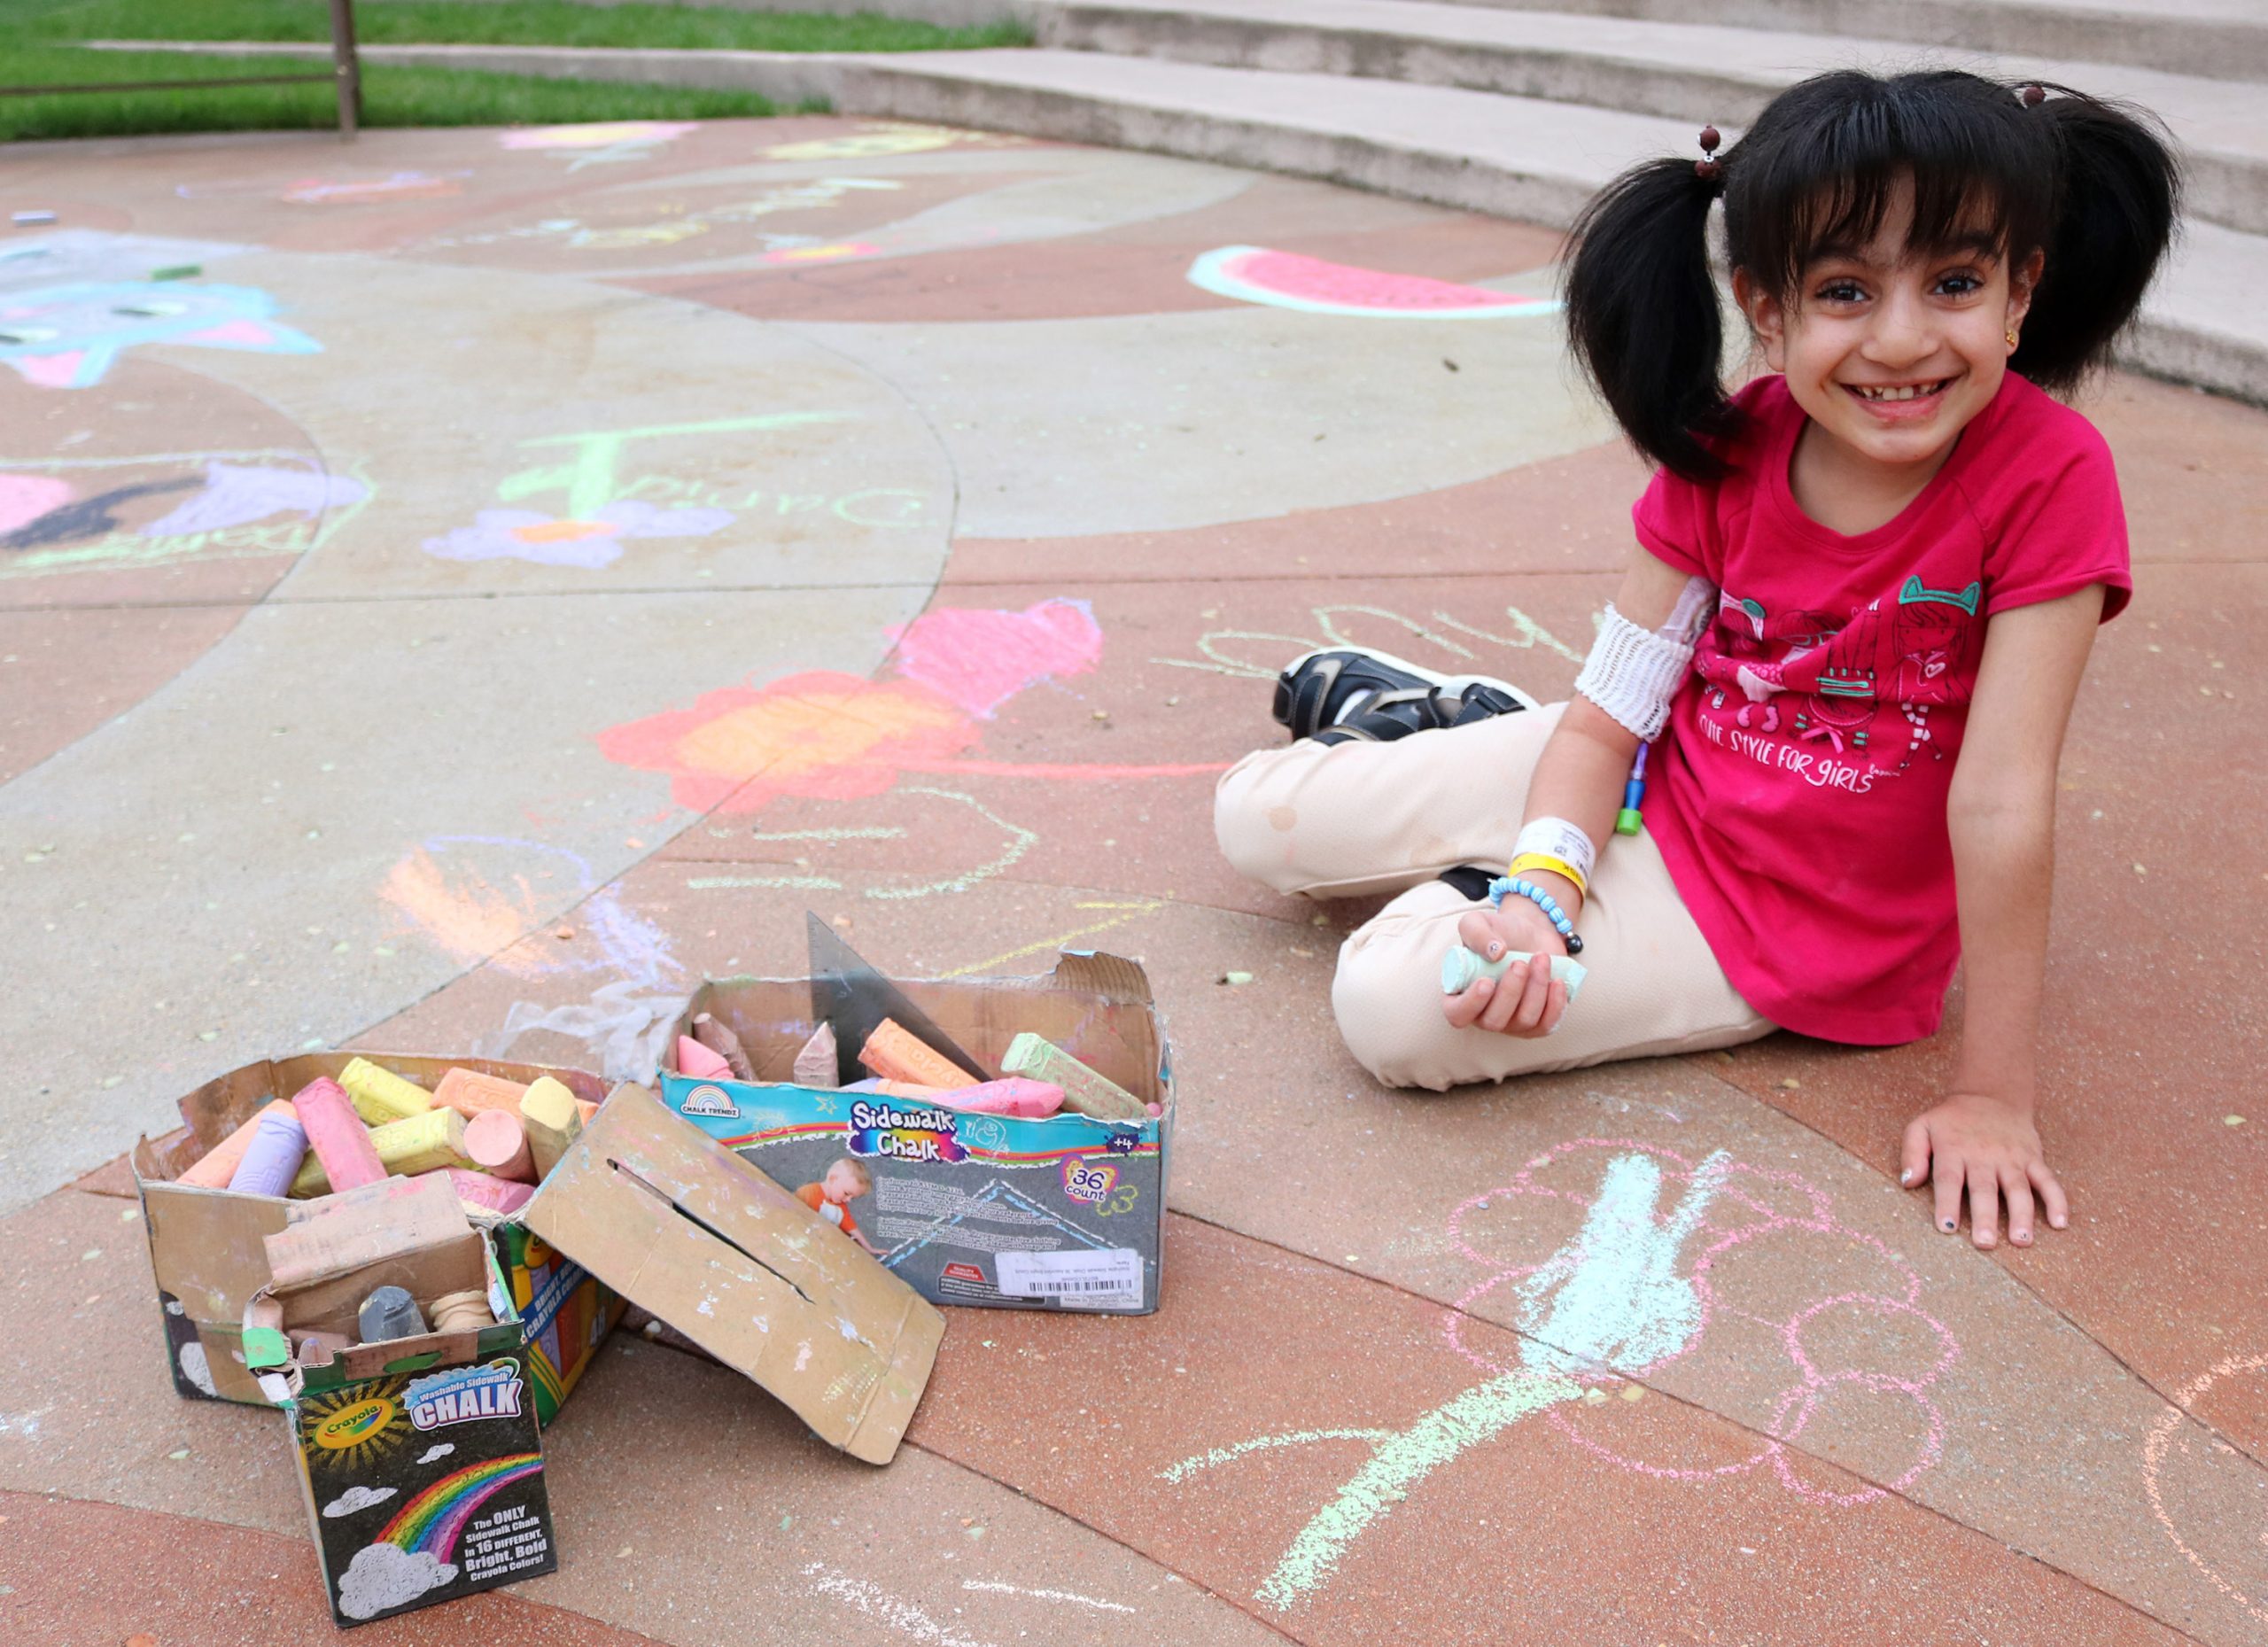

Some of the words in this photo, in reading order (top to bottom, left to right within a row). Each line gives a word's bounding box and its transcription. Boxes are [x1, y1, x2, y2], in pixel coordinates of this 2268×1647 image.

[1777, 745, 1814, 774] FOR
[852, 1101, 955, 1132] Sidewalk
[877, 1132, 941, 1161] Chalk
[1114, 1138, 1133, 1150] +4
[1066, 1185, 1105, 1201] count
[1073, 1169, 1105, 1190] 36
[526, 1290, 562, 1338] CRAYOLA
[419, 1381, 465, 1402] Washable
[467, 1372, 509, 1388] Sidewalk
[413, 1381, 518, 1427] CHALK
[327, 1405, 378, 1433] Crayola
[465, 1525, 511, 1543] Sidewalk
[511, 1516, 540, 1532] Chalk
[473, 1519, 493, 1531] The
[493, 1504, 526, 1525] ONLY
[465, 1550, 514, 1572] Bright,
[515, 1539, 548, 1558] Bold
[476, 1539, 493, 1554] 16
[470, 1565, 509, 1581] Crayola
[509, 1554, 544, 1571] Colors!
